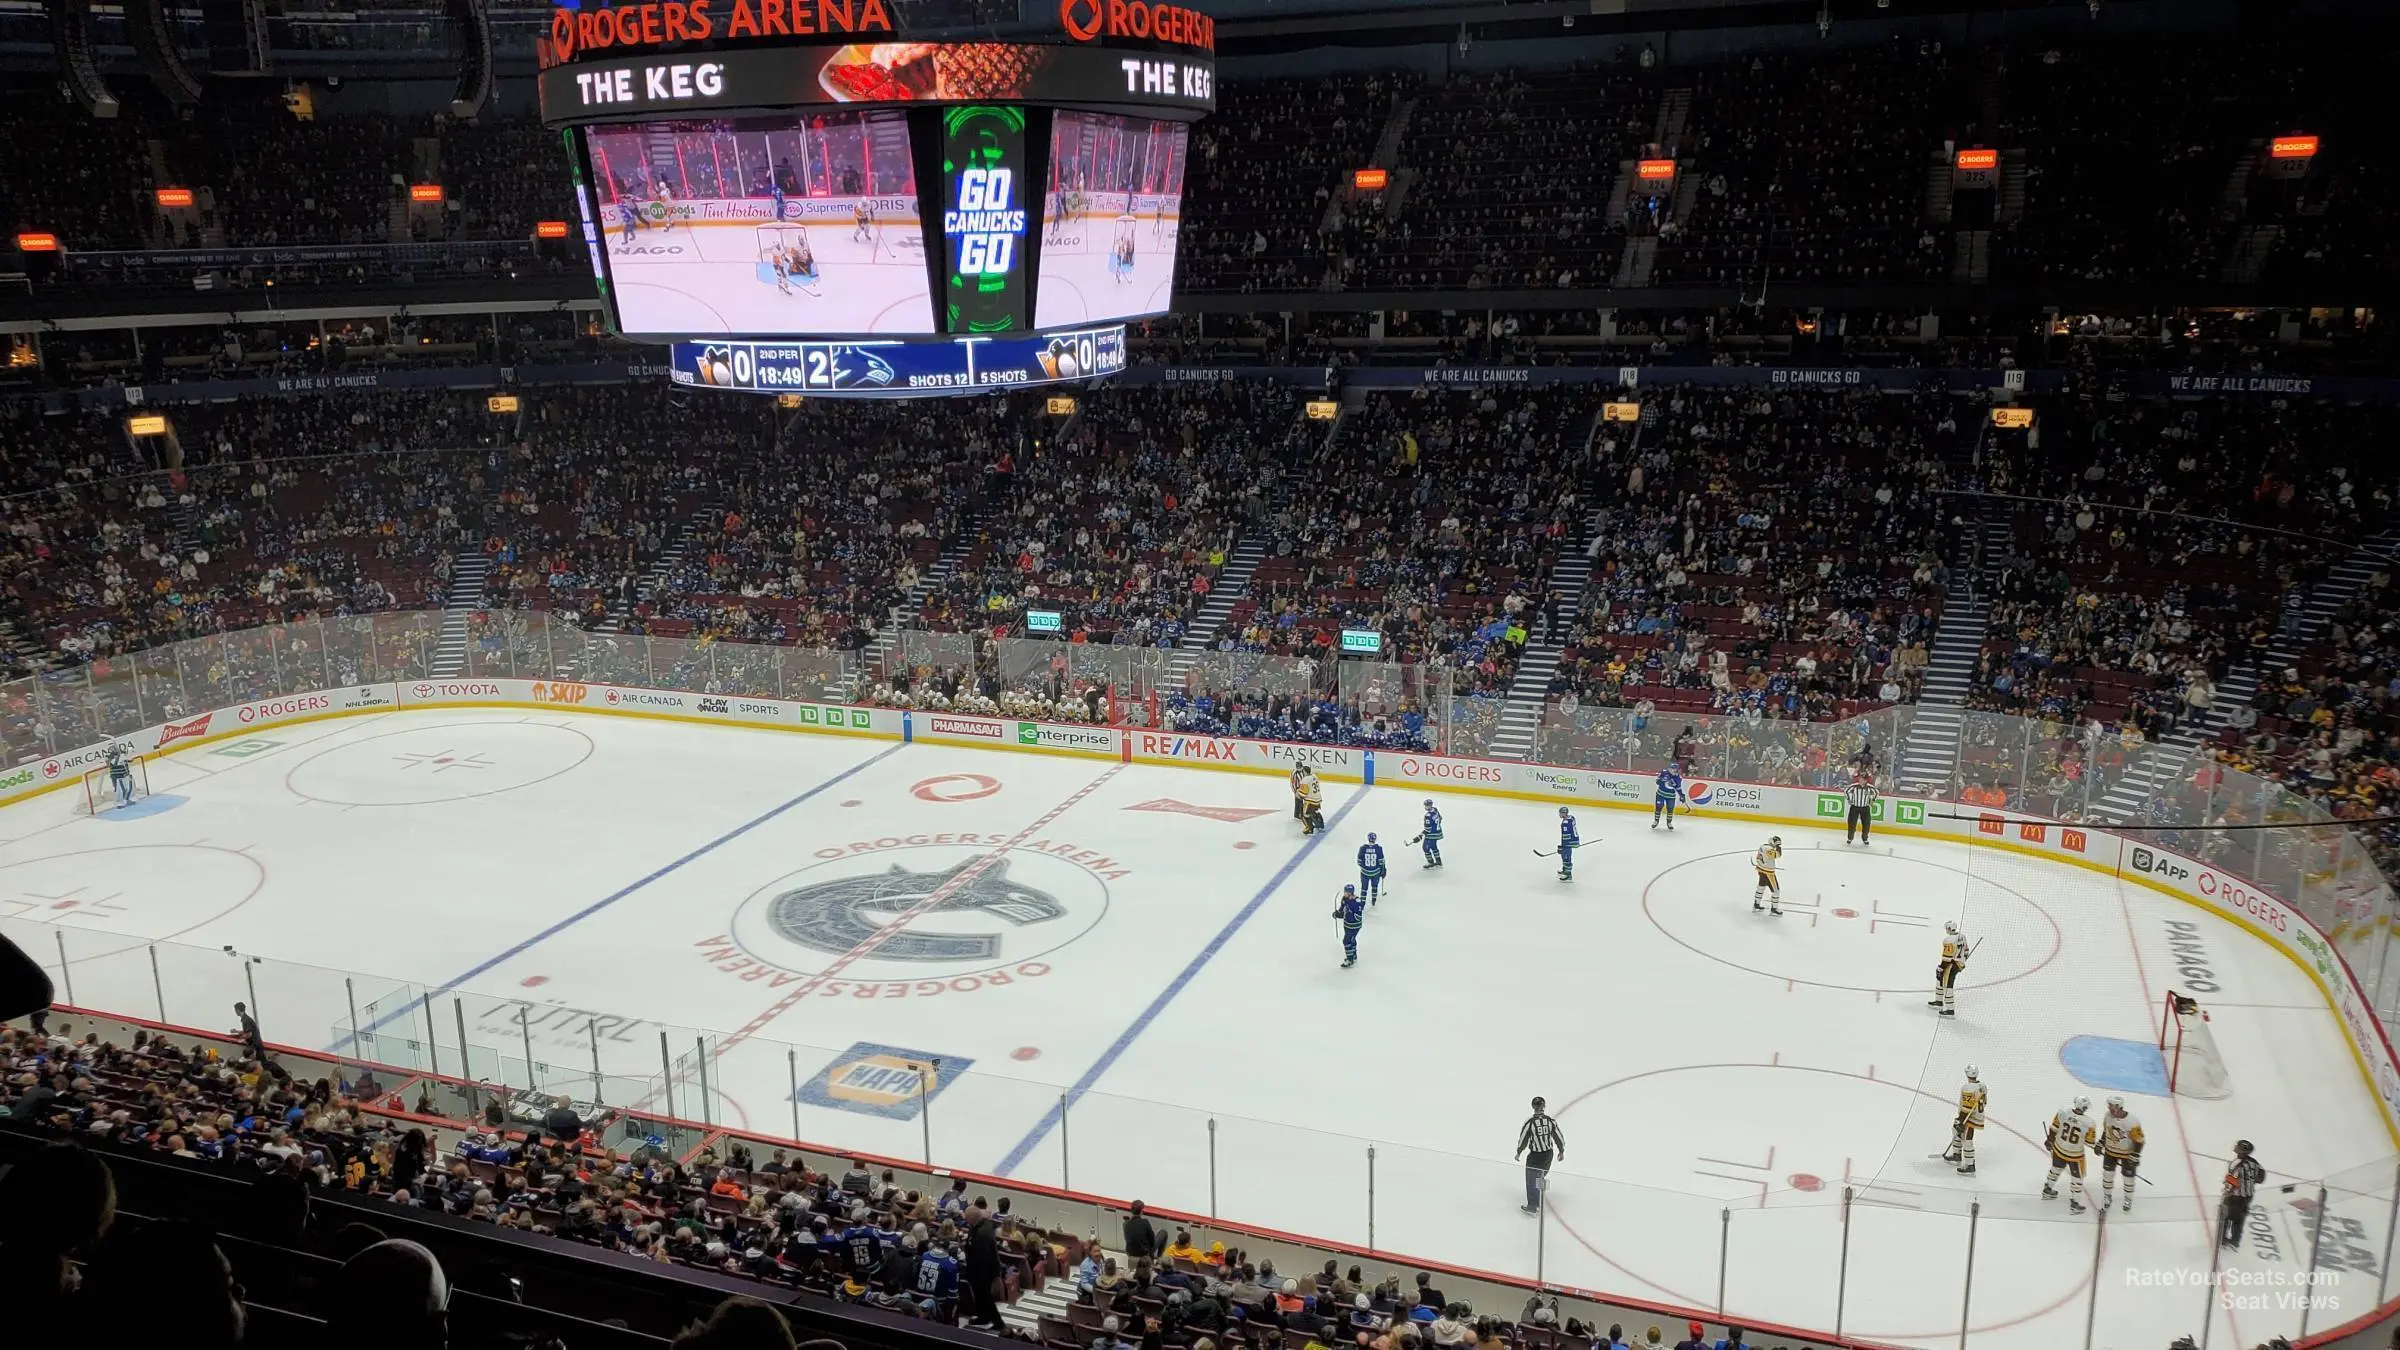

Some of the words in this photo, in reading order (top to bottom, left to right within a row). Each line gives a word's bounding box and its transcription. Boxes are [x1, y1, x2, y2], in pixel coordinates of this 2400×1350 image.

[578, 0, 712, 49] ROGERS
[728, 0, 891, 37] ARENA
[1108, 0, 1201, 46] ROGERS
[577, 70, 633, 105] THE
[646, 63, 723, 100] KEG
[1122, 59, 1175, 95] THE
[1184, 64, 1210, 99] KEG
[1647, 165, 1672, 173] ROGERS
[959, 168, 1012, 211] GO
[944, 211, 1024, 232] CANUCKS
[960, 233, 1013, 274] GO
[760, 350, 777, 359] 2ND
[779, 350, 799, 359] PER
[1080, 339, 1091, 369] 0
[643, 366, 671, 376] CANUC
[734, 350, 751, 383] 0
[759, 366, 801, 384] 18:49
[809, 351, 829, 384] 2
[1179, 369, 1219, 380] CANUCKS
[1424, 369, 1438, 381] WE
[1441, 369, 1461, 381] ARE
[1463, 369, 1480, 381] ALL
[1483, 370, 1528, 382] CANUCKS
[278, 380, 292, 390] WE
[296, 379, 312, 390] ARE
[334, 376, 377, 388] CANUCKS
[909, 375, 951, 387] SHOTS
[954, 374, 967, 385] 12
[981, 371, 988, 383] 5
[990, 370, 1027, 382] SHOTS
[1772, 371, 1787, 382] GO
[1791, 371, 1841, 383] CANUCKS
[2170, 376, 2189, 390] WE
[2221, 377, 2245, 391] ALL
[2249, 378, 2312, 393] CANUCKS
[438, 684, 500, 696] TOYOTA
[550, 683, 587, 704] SKIP
[260, 695, 329, 718] ROGERS
[622, 693, 638, 704] AIR
[641, 694, 683, 707] CANADA
[702, 705, 728, 713] NOW
[703, 698, 728, 706] PLAY
[739, 703, 779, 715] SPORTS
[802, 708, 817, 722] TD
[827, 710, 842, 724] TD
[853, 713, 869, 726] TD
[933, 720, 1001, 736] PHARMASAVE
[1019, 727, 1109, 745] enterprise
[63, 755, 84, 770] AIR
[85, 740, 135, 763] CANDA
[1143, 735, 1238, 761] RE/MAX
[1273, 745, 1348, 765] FASKEN
[1425, 762, 1501, 782] ROGERS
[1536, 772, 1578, 785] NexGen
[1552, 784, 1577, 792] Energy
[1597, 779, 1640, 792] NexGen
[1614, 791, 1640, 799] Energy
[1716, 787, 1762, 804] pepsi
[1824, 797, 1843, 813] TD
[1904, 804, 1922, 821] TD
[849, 832, 1007, 850] ROGERS
[1024, 838, 1132, 882] ARENA
[1365, 853, 1377, 866] 88
[2222, 883, 2288, 932] ROGERS
[693, 933, 803, 989] ARENA
[2164, 919, 2222, 994] PANAGO
[819, 968, 1015, 999] ROGERS
[839, 1064, 920, 1095] NAPA
[1537, 1126, 1549, 1136] 90
[2060, 1122, 2082, 1145] 26
[2249, 1204, 2282, 1262] SPORTS
[917, 1267, 939, 1292] 53
